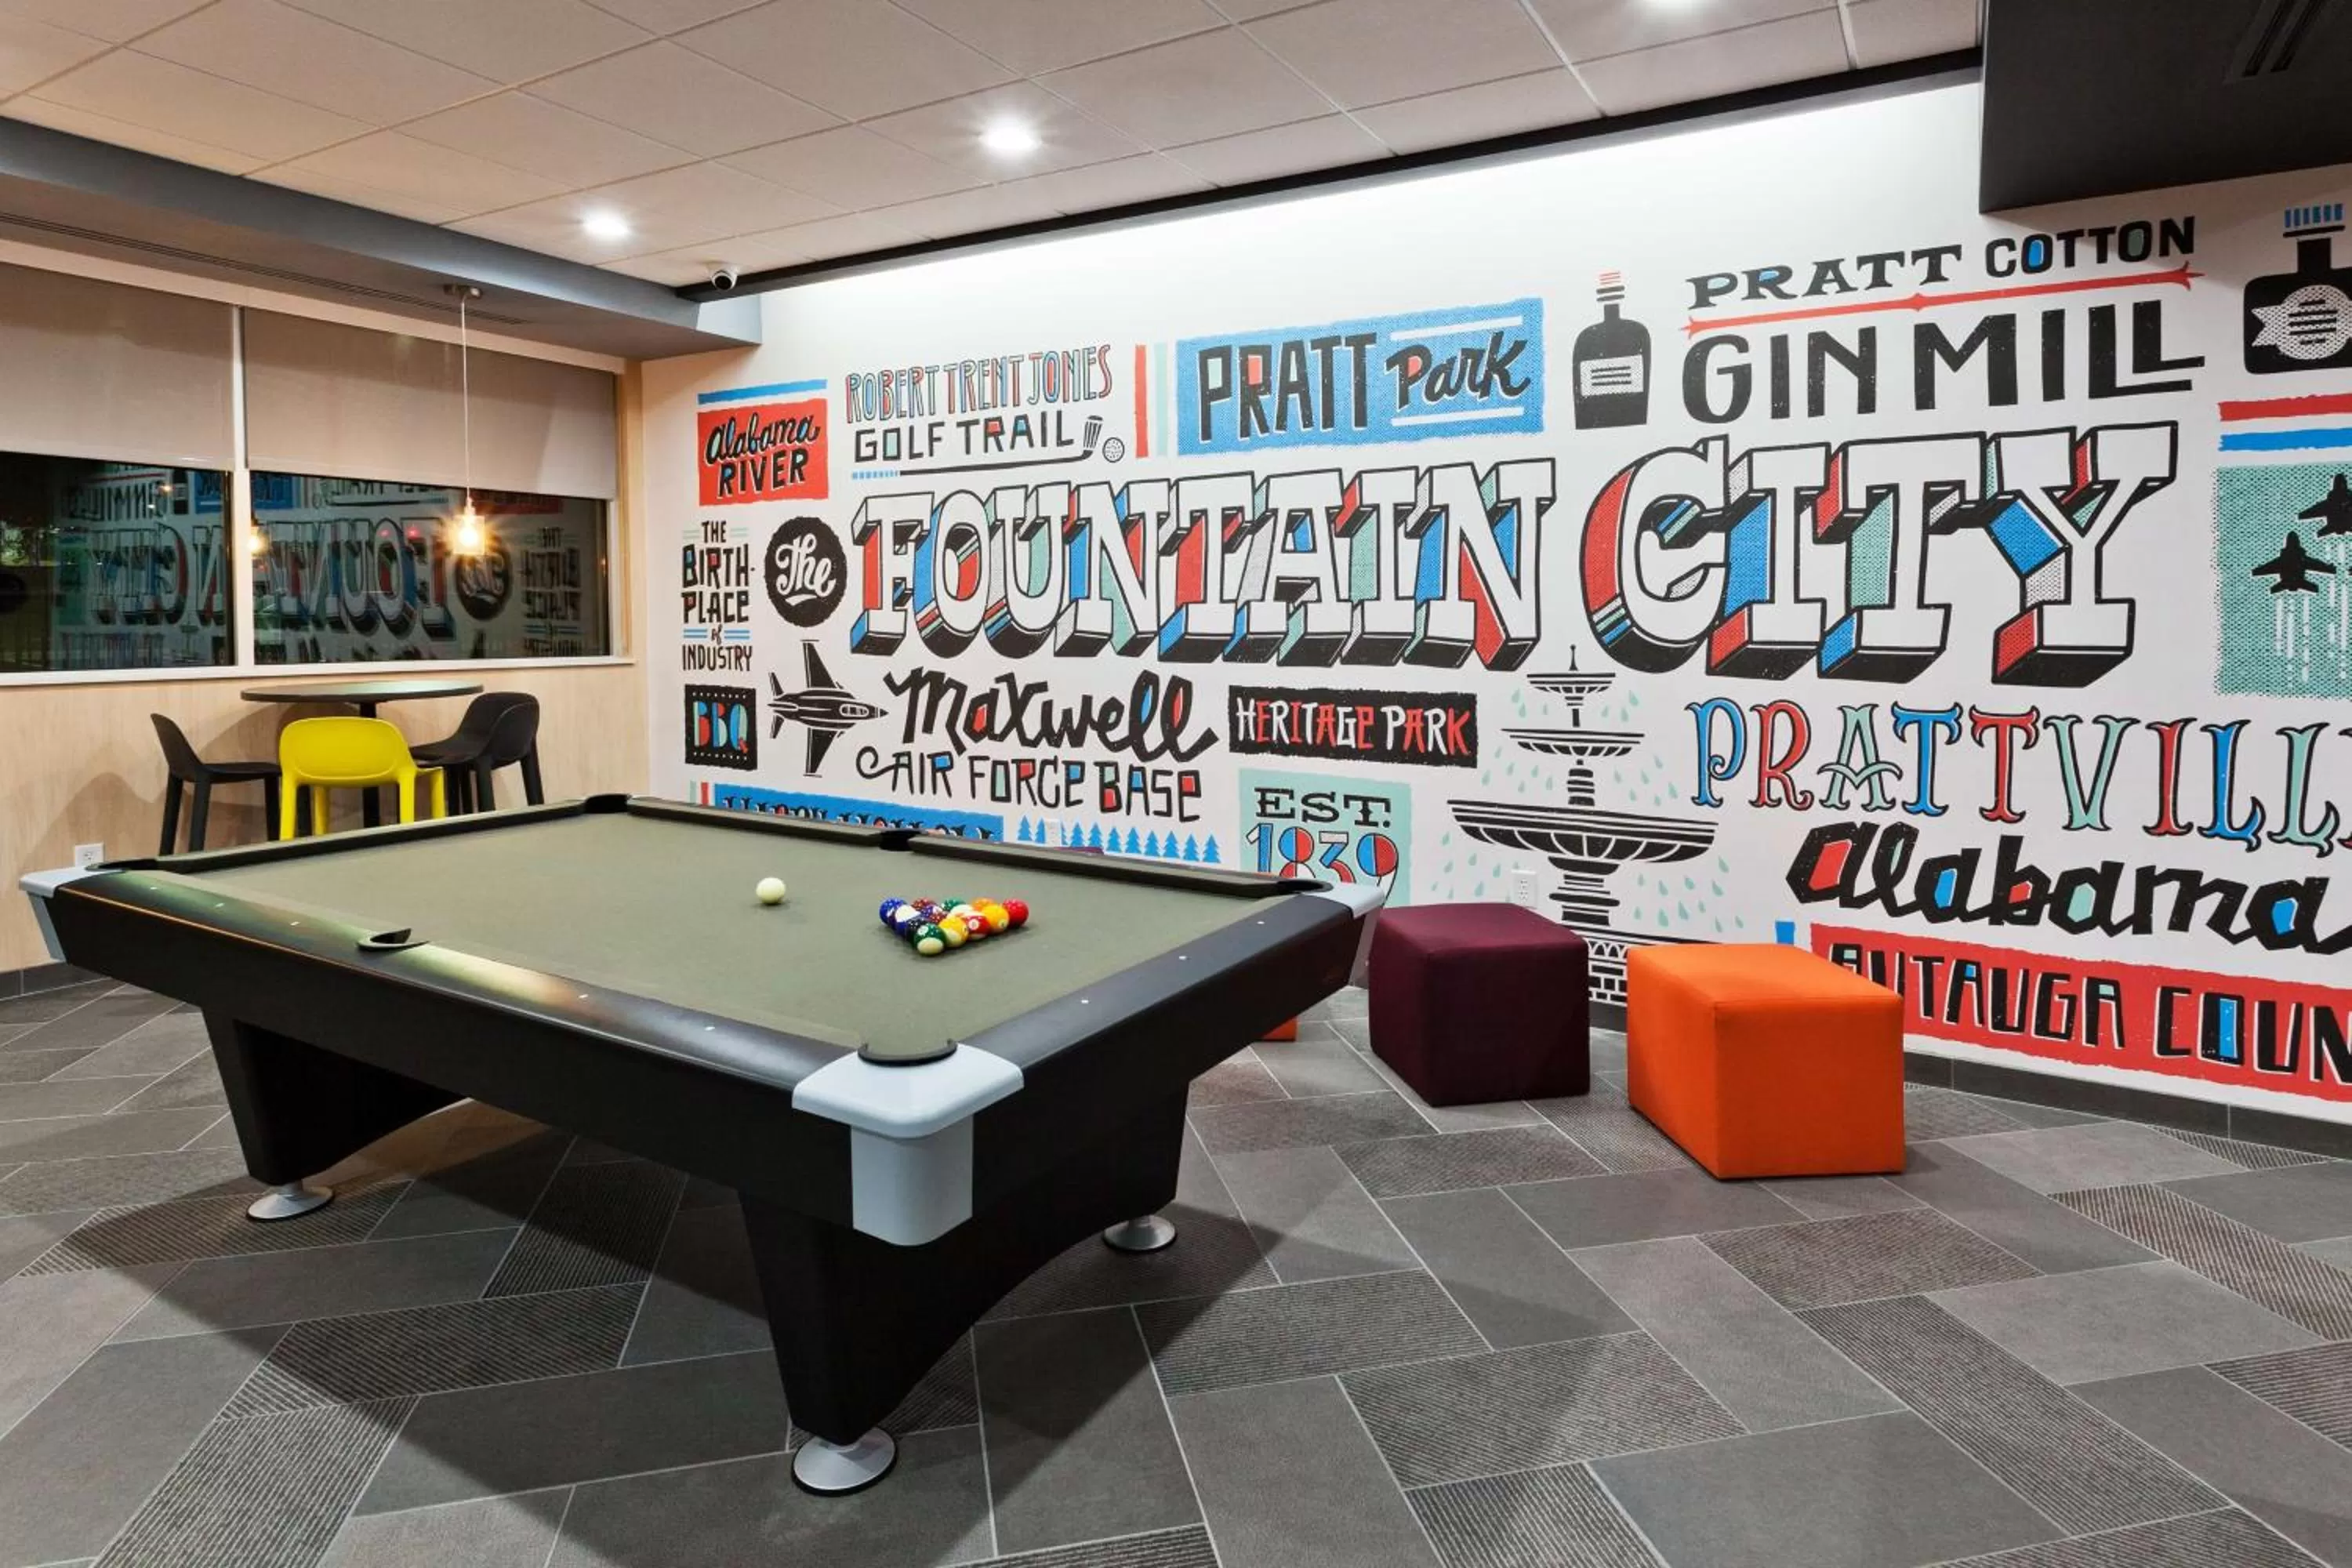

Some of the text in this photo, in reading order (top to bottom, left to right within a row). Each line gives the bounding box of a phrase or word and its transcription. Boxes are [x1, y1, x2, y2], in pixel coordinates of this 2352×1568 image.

[1686, 215, 2197, 310] PRATT COTTON
[845, 343, 1114, 424] ROBERT TRENT JONES
[1198, 332, 1532, 443] PRATT Park
[1681, 299, 2205, 425] GIN MILL
[855, 411, 1075, 463] GOLF TRAIL
[717, 453, 807, 499] RIVER
[701, 520, 728, 543] THE
[776, 421, 2179, 688] The FOUNTAIN CITY
[682, 543, 756, 589] BIRTH-
[681, 590, 750, 624] PLACE
[682, 644, 753, 671] INDUSTRY
[692, 701, 749, 753] BBQ
[883, 666, 1220, 763] Maxwell
[1236, 697, 1470, 756] HERITAGE PARK
[856, 745, 1202, 823] AIR FORCE BASE
[1254, 786, 1392, 828] EST.
[1684, 697, 2352, 858] PRATTVILL
[1246, 822, 1399, 908] 1839
